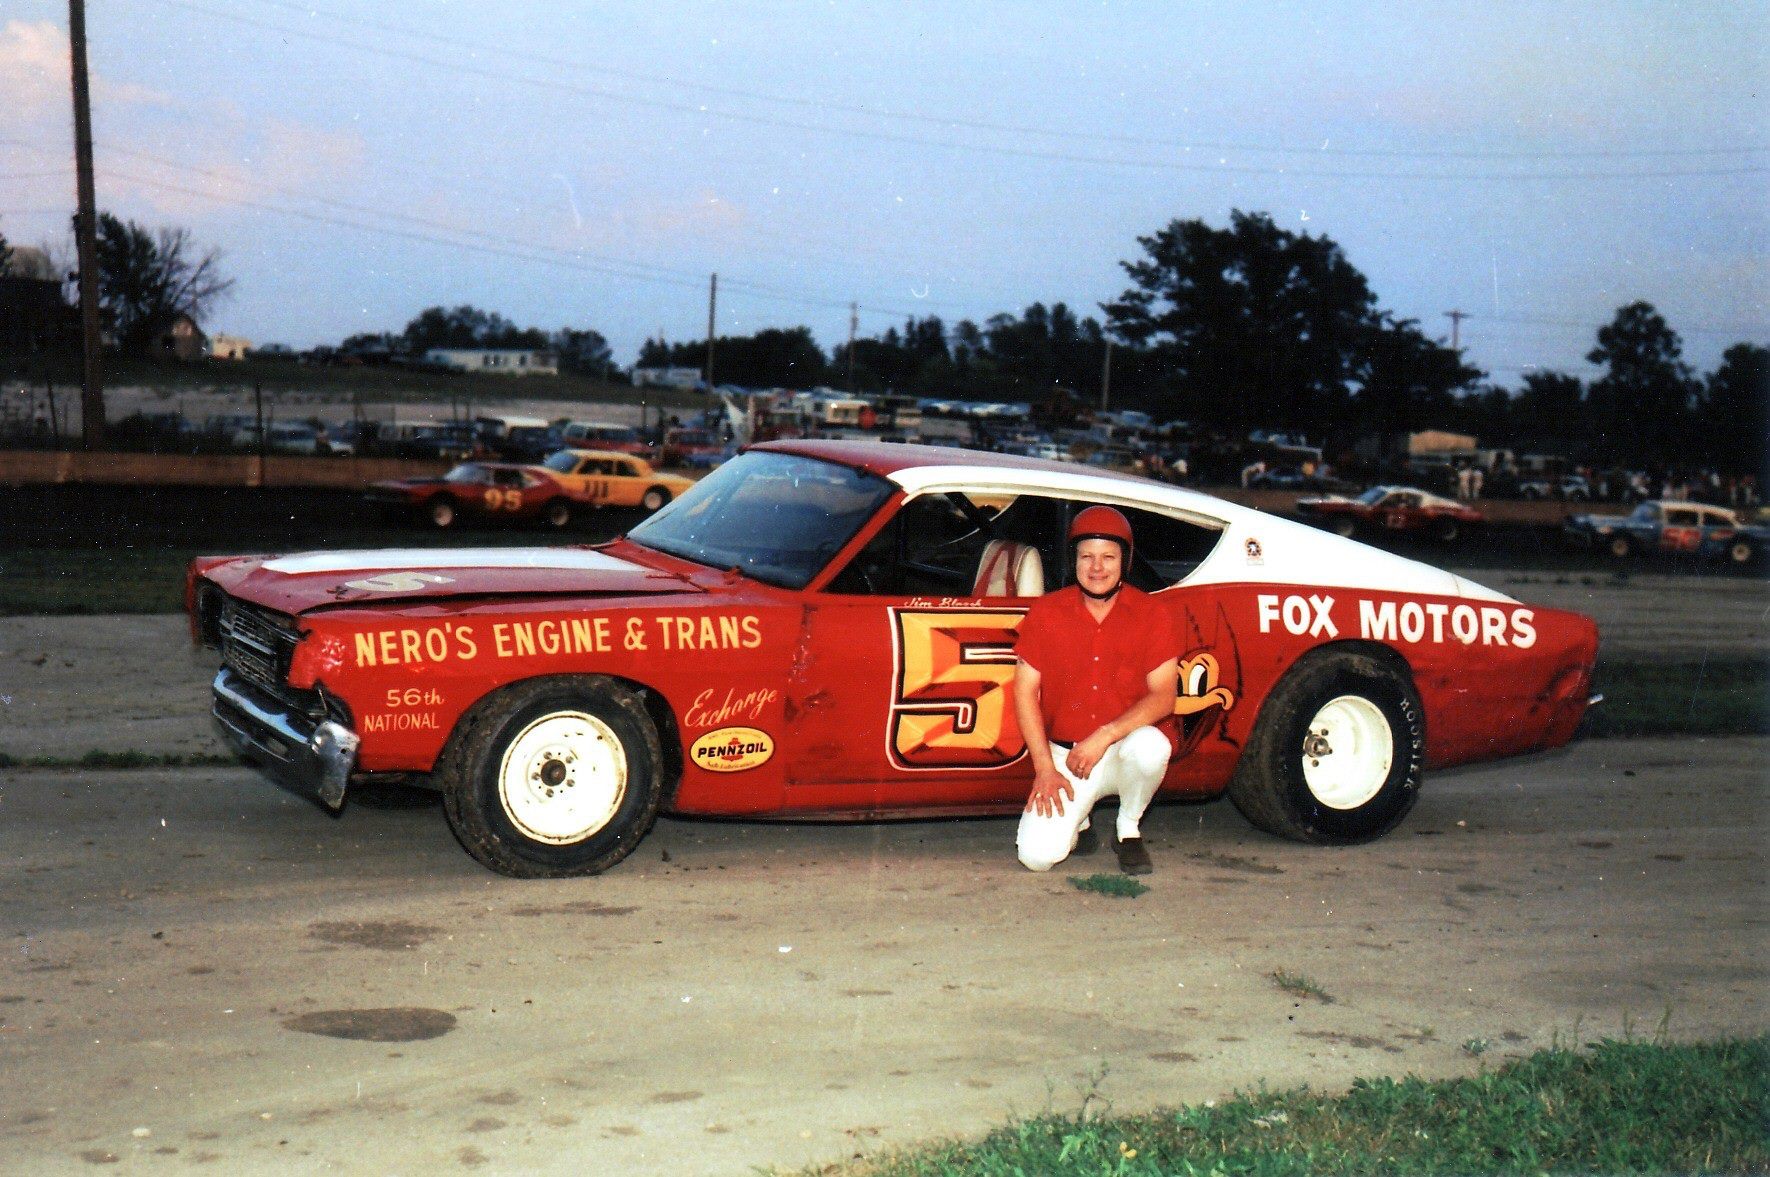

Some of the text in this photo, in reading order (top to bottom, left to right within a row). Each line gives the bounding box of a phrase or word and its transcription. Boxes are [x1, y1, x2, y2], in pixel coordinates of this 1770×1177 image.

[484, 488, 523, 512] 95
[1257, 593, 1538, 649] FOX MOTORS
[354, 615, 762, 667] NERO'S ENGINE & TRANS
[386, 687, 445, 708] 56th
[885, 605, 1030, 771] 5
[364, 711, 441, 733] NATIONAL
[684, 687, 778, 728] Exchange
[697, 741, 768, 759] PENNZOIL
